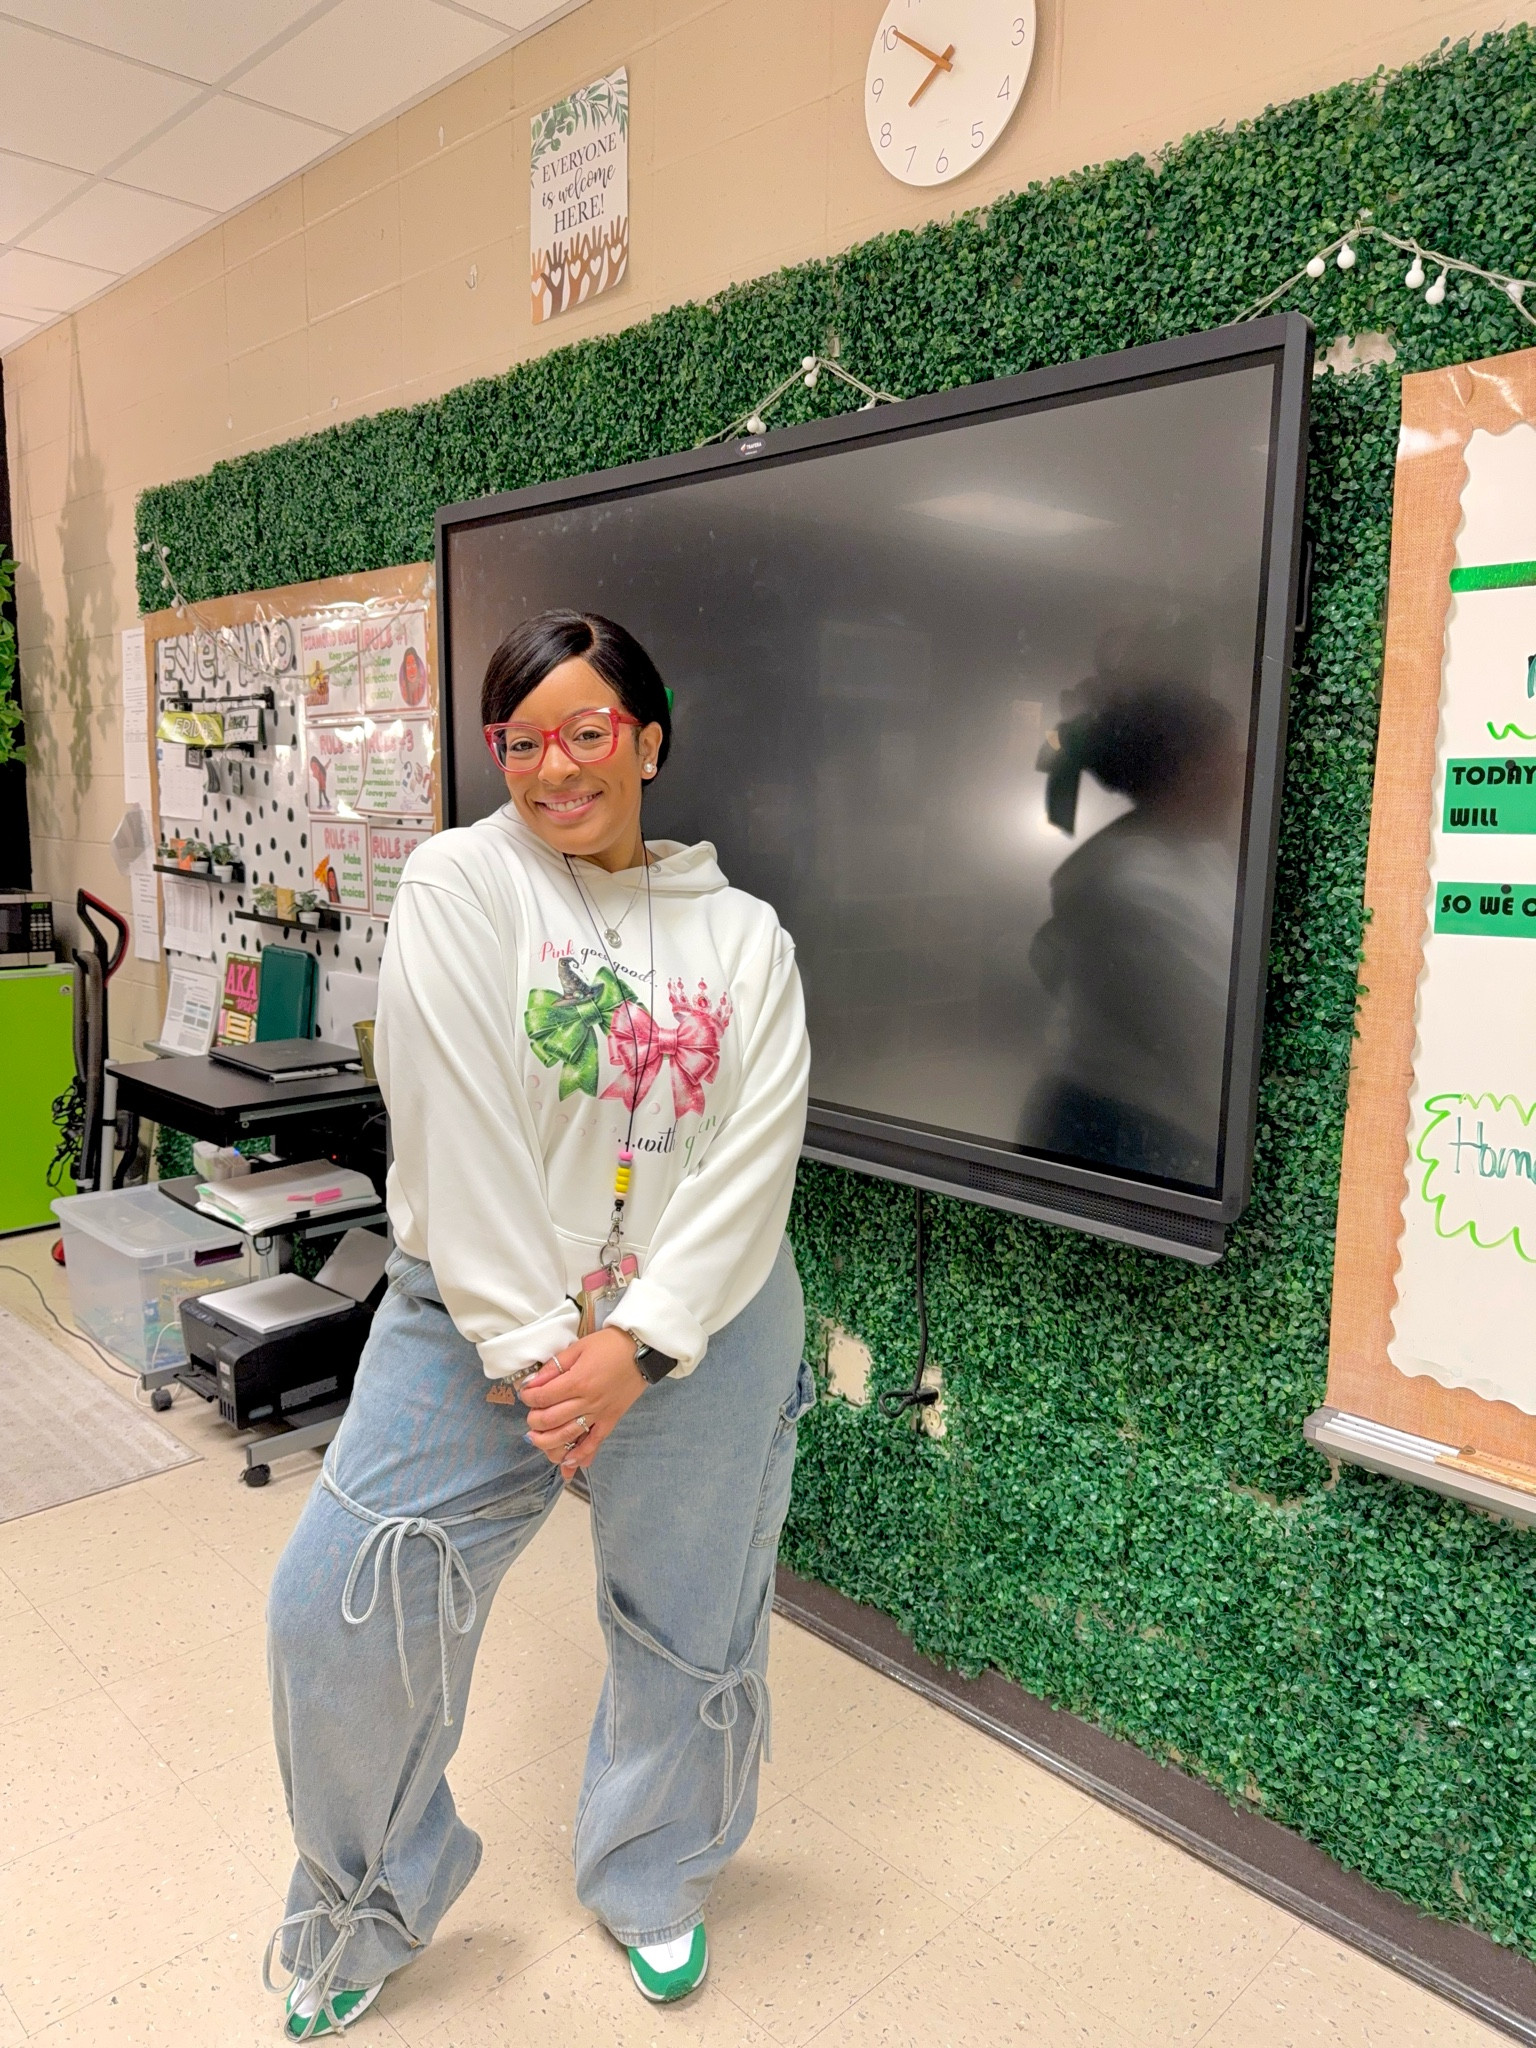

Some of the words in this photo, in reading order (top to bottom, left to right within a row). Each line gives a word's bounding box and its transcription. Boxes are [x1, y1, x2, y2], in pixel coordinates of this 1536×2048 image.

[880, 25, 898, 53] 10
[1011, 18, 1025, 46] 3
[872, 78, 884, 103] 9
[997, 75, 1010, 101] 4
[880, 122, 892, 148] 8
[971, 121, 984, 149] 5
[542, 132, 617, 184] EVERYONE
[905, 145, 917, 173] 7
[936, 148, 949, 174] 6
[542, 191, 555, 210] is
[558, 163, 616, 202] welcome
[554, 193, 604, 235] HERE!
[1450, 807, 1498, 827] WILL
[324, 827, 346, 850] RULE
[348, 829, 360, 851] #4
[372, 835, 401, 860] RULE
[343, 852, 361, 865] Make
[374, 863, 391, 874] Make
[342, 871, 362, 883] smart
[341, 886, 365, 899] choices
[1441, 894, 1472, 914] SO
[1479, 896, 1514, 916] WE
[541, 939, 575, 963] Pink
[581, 948, 609, 965] goes
[224, 963, 258, 1001] AKA
